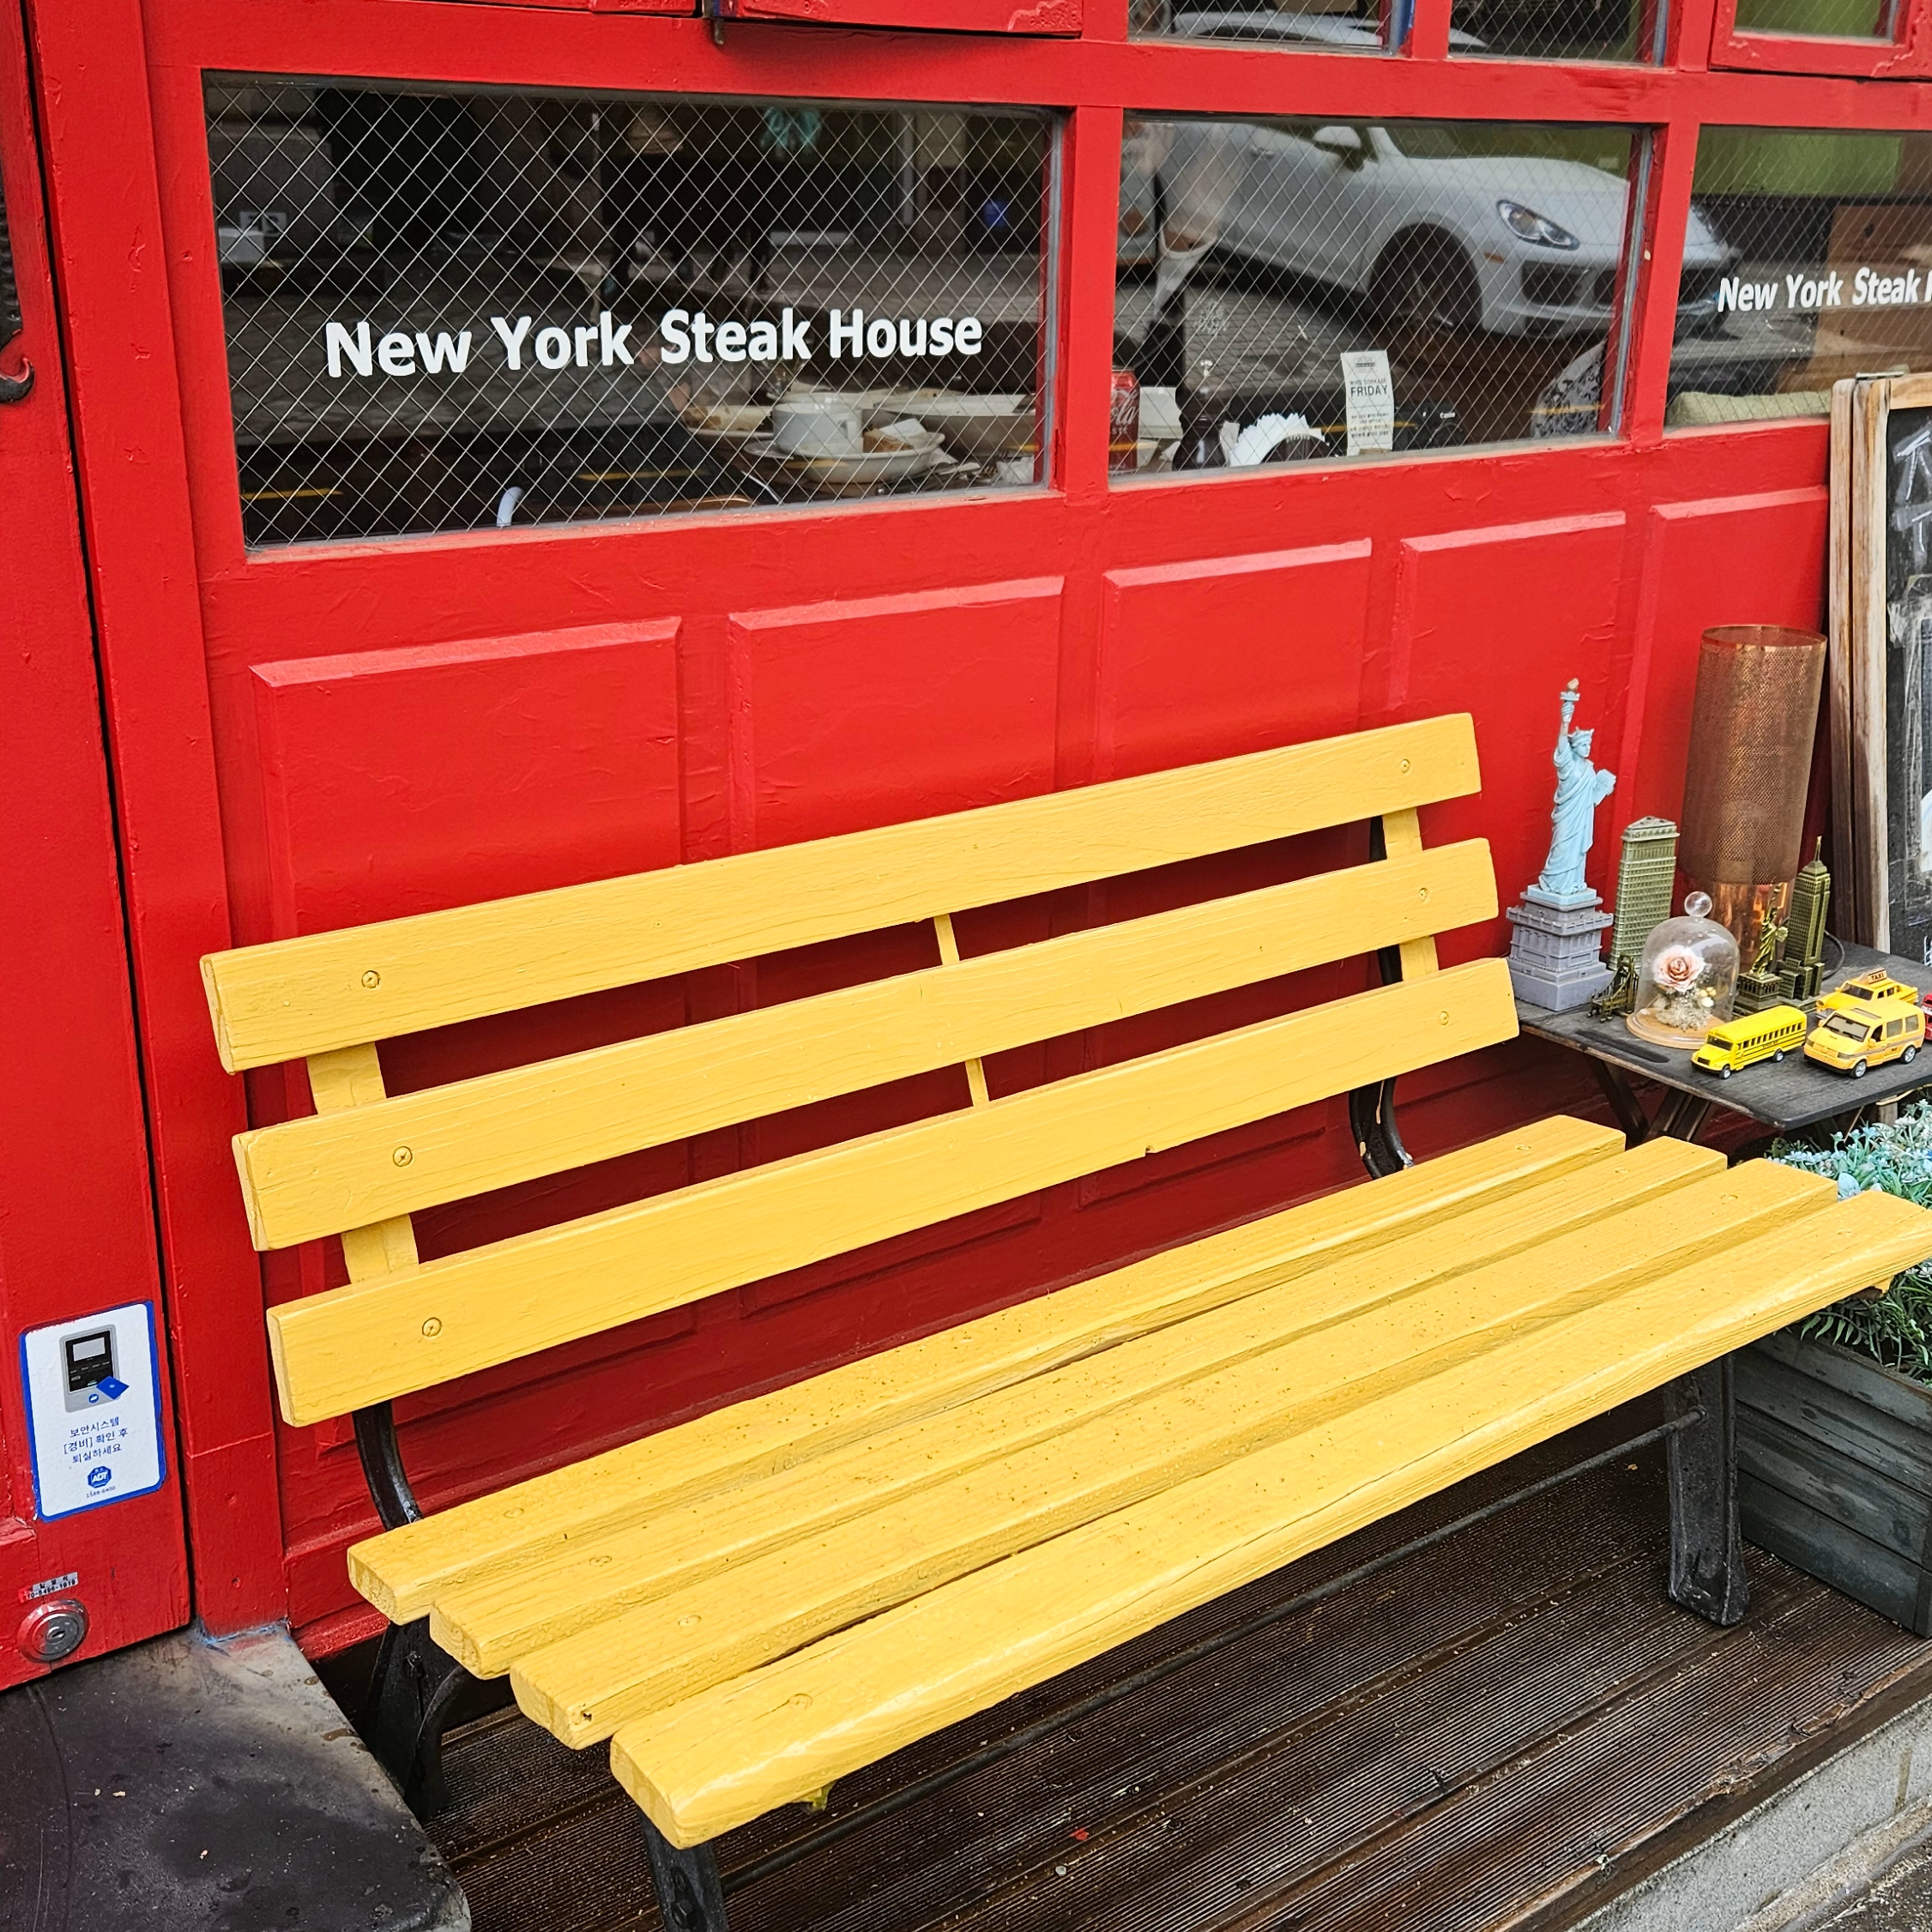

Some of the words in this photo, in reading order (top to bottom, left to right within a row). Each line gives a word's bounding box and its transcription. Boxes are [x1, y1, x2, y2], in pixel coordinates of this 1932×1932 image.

[1717, 275, 1778, 312] New
[1785, 270, 1844, 309] York
[1851, 266, 1922, 305] Steak
[325, 318, 472, 377] New
[491, 311, 635, 371] York
[660, 308, 812, 365] Steak
[829, 309, 983, 359] House
[1350, 384, 1388, 397] FRIDAY
[1870, 972, 1885, 981] TAXI
[69, 1416, 119, 1438] 보안시스템
[63, 1436, 94, 1455] [경비]
[95, 1430, 116, 1444] 확인
[118, 1428, 129, 1438] 후
[72, 1443, 123, 1464] 퇴실하세요
[91, 1470, 109, 1483] ADT
